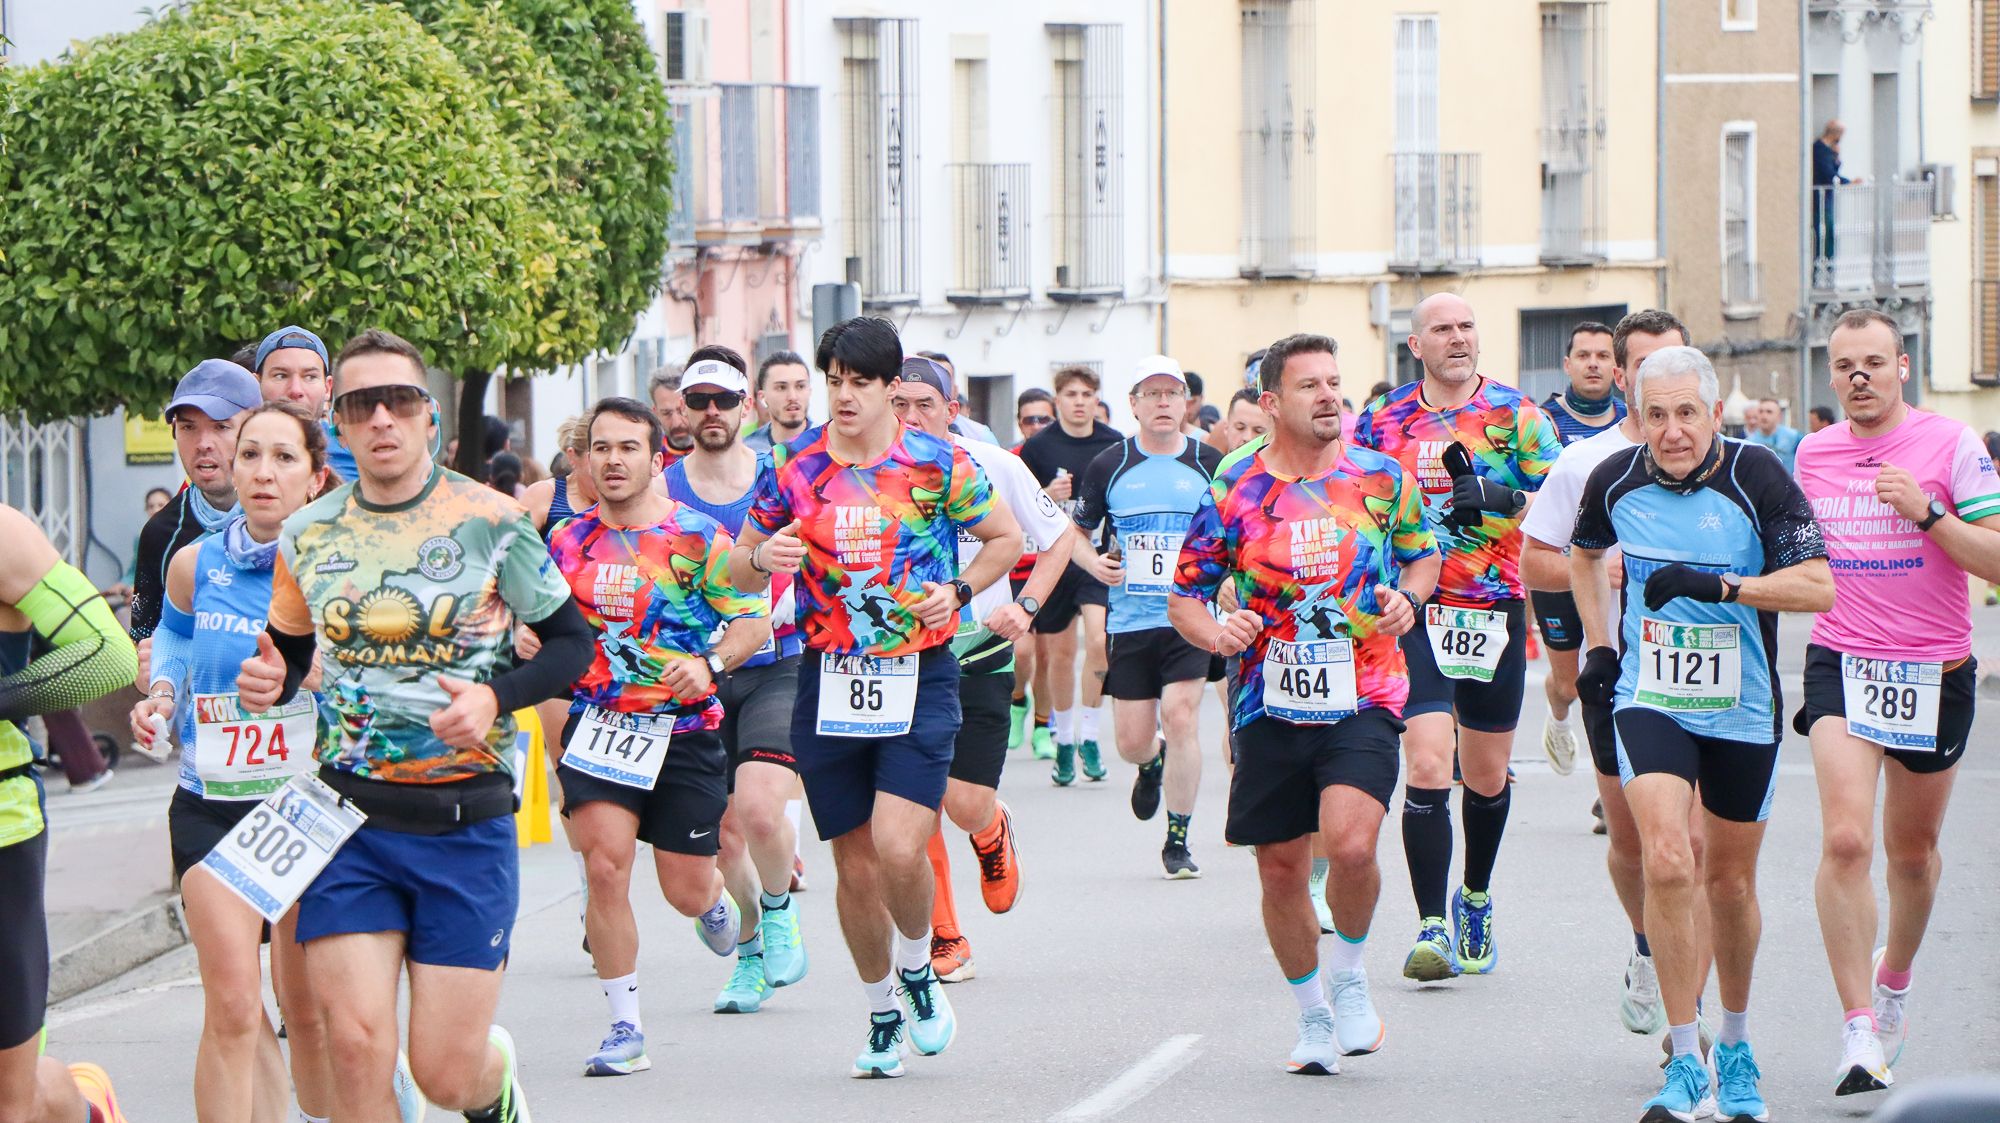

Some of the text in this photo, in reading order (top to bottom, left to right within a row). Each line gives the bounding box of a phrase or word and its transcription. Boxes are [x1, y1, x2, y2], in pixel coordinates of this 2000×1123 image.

[1417, 459, 1445, 468] MEDIA
[1417, 469, 1451, 478] MARAT
[1423, 479, 1439, 488] 10K
[835, 506, 864, 528] XII
[865, 506, 881, 520] 08
[834, 528, 865, 540] MEDIA
[1289, 519, 1320, 544] XII
[1320, 518, 1336, 532] 08
[1820, 519, 1921, 537] TERNACIONAL 202
[835, 536, 881, 551] MARATÓN
[1290, 541, 1322, 556] MEDIA
[1888, 539, 1923, 549] MARATHON
[843, 551, 861, 563] 10K
[1152, 553, 1164, 576] 6
[1291, 549, 1338, 567] MARATÓN
[1829, 557, 1924, 571] ORREMOLINOS
[594, 563, 623, 585] XII
[622, 565, 638, 578] 08
[1299, 565, 1317, 578] 10K
[593, 583, 621, 596] MEDIA
[593, 594, 635, 608] MARATÓN
[600, 606, 617, 616] 10K
[1432, 608, 1458, 629] 10K
[195, 611, 268, 636] TROTAS
[1441, 629, 1487, 657] 482
[1648, 622, 1676, 647] 10K
[1274, 641, 1298, 664] 21K
[1652, 648, 1720, 685] 1121
[1857, 657, 1889, 682] 21K
[1280, 667, 1330, 699] 464
[850, 678, 883, 711] 85
[1863, 684, 1918, 720] 289
[202, 696, 241, 722] 10K
[222, 723, 289, 767] 724
[588, 726, 654, 763] 1147
[236, 809, 308, 878] 308
